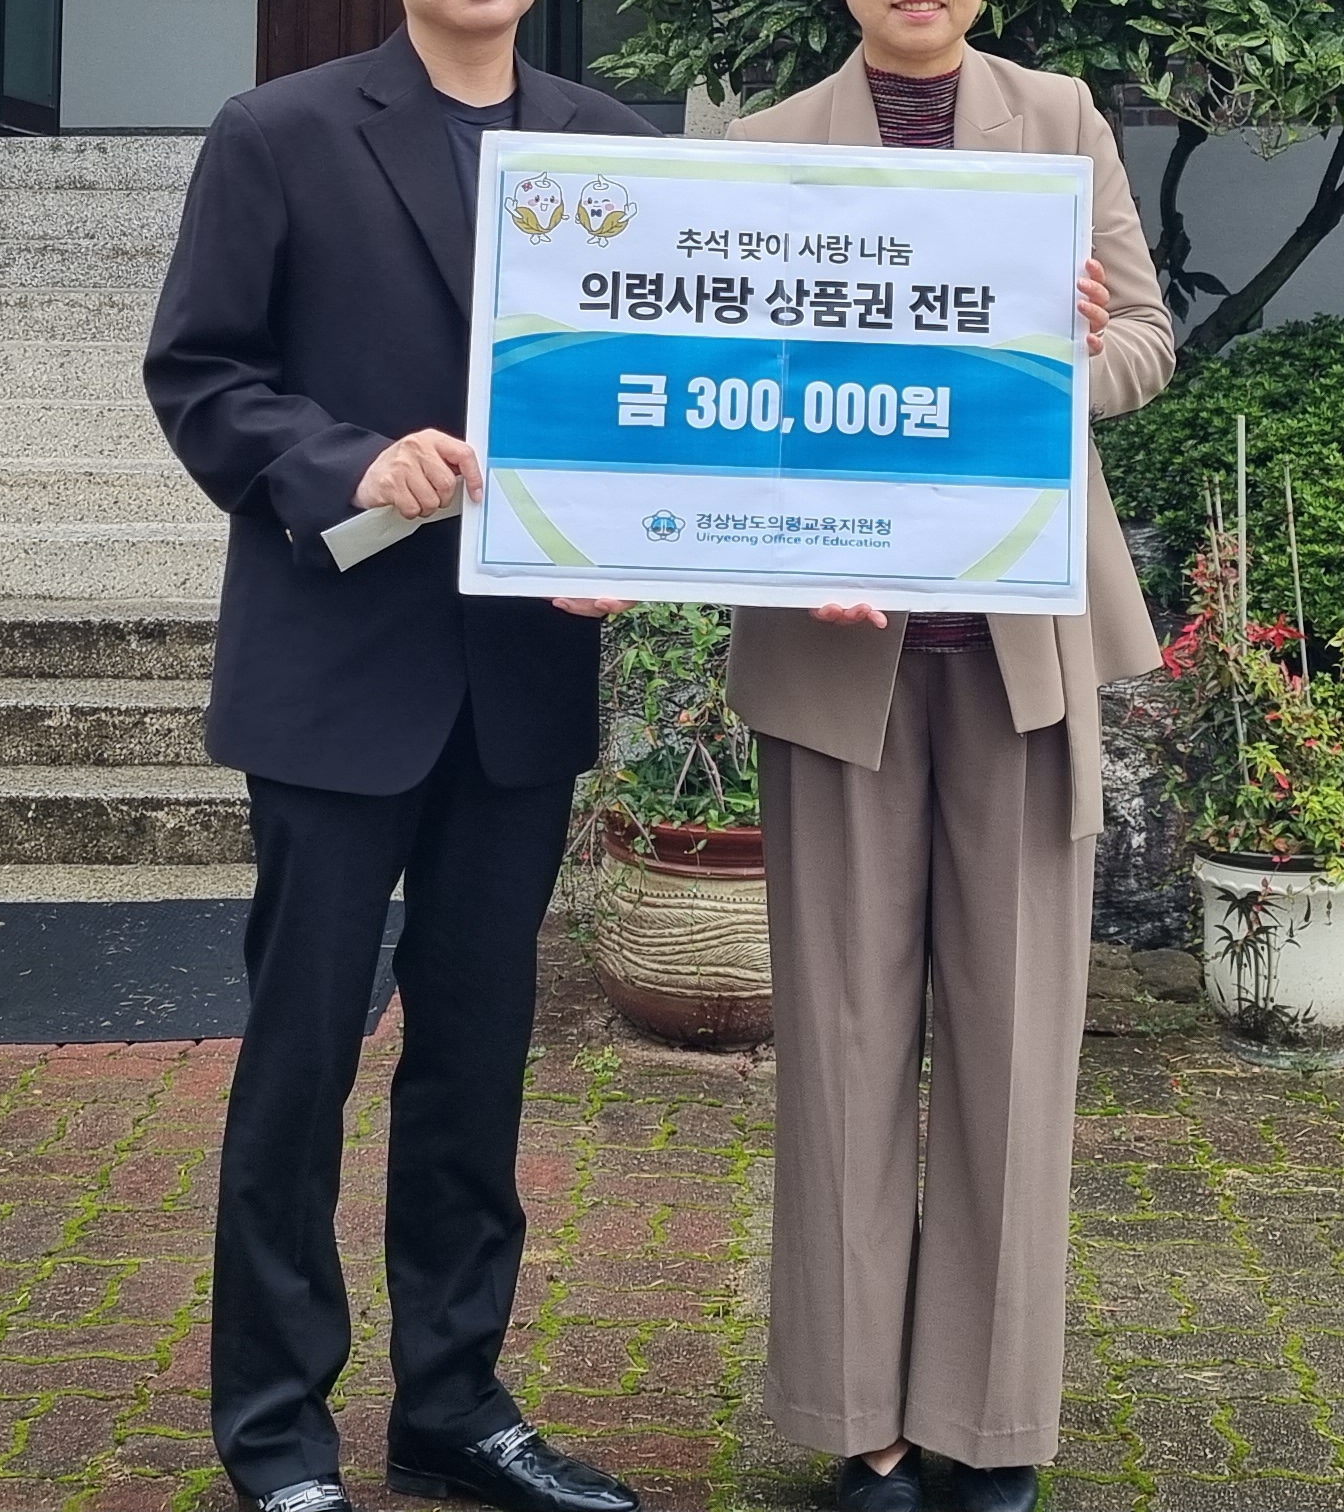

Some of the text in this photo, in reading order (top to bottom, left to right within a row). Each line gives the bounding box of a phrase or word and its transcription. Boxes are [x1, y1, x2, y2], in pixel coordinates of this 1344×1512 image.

[676, 228, 914, 267] 추석 맞이 사랑 나눔
[579, 270, 997, 335] 의령사랑 상품권 전달
[617, 373, 952, 439] 금 300,000원
[695, 512, 893, 536] 경상남도의령교육지원청
[695, 532, 892, 549] Uiryeong Office of Education
